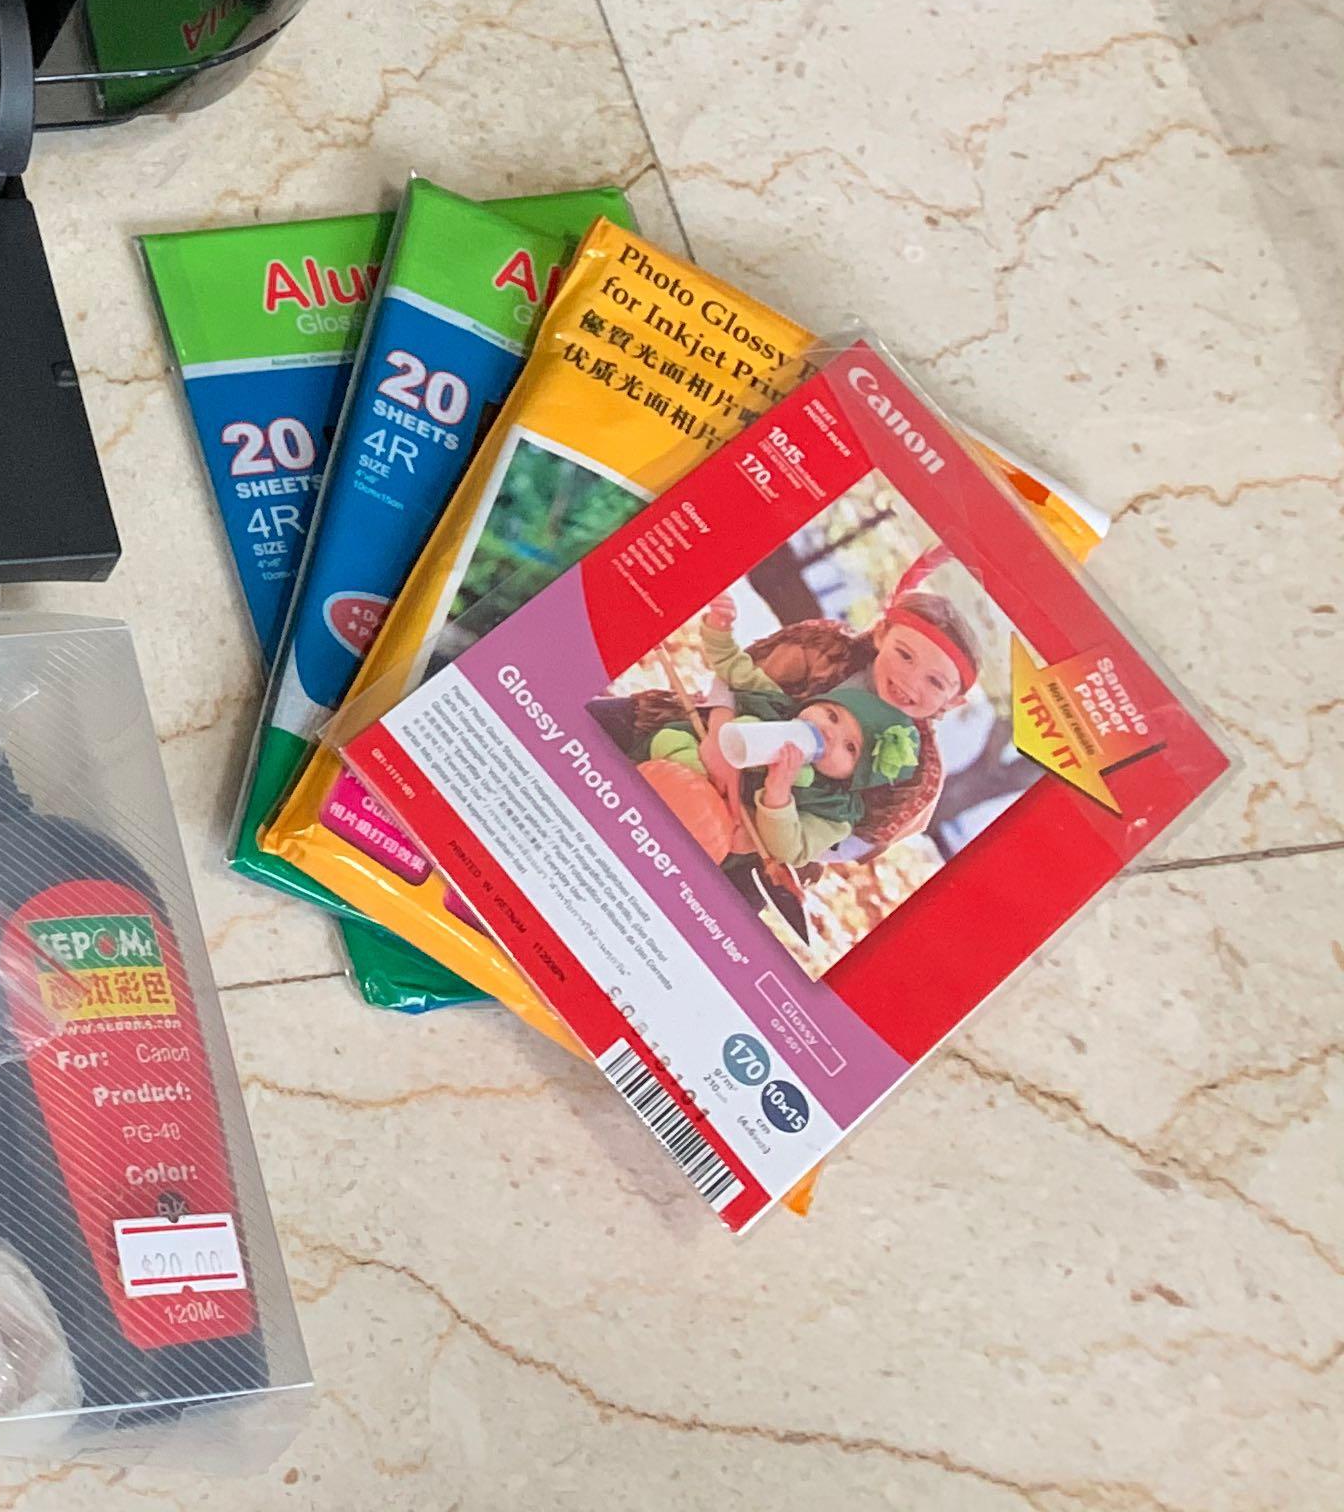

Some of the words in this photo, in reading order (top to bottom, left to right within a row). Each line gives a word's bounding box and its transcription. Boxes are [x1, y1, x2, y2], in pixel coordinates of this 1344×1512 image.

[599, 275, 642, 313] for
[642, 301, 729, 370] Inkjet
[617, 242, 695, 308] Photo
[701, 299, 794, 372] Glossy
[377, 349, 470, 426] 20
[221, 416, 318, 477] 20
[372, 398, 460, 452] SHEETS
[803, 404, 829, 433] PHOTO
[826, 431, 852, 458] PAPER
[848, 367, 946, 474] Canon
[358, 453, 391, 478] SIZE
[363, 428, 419, 475] 4R
[247, 504, 306, 539] 4R
[253, 541, 288, 557] SIZE
[1074, 683, 1112, 736] Pack
[1086, 671, 1130, 733] Paper
[1096, 657, 1148, 736] Sample
[1020, 686, 1065, 739] TRY
[1052, 745, 1082, 769] IT
[498, 665, 565, 742] Glossy
[560, 738, 620, 810] Photo
[618, 807, 681, 878] Paper
[680, 881, 725, 940] "Everyday
[722, 937, 750, 964] Use"
[781, 1001, 819, 1047] Glossy
[57, 1050, 109, 1070] For:
[136, 1043, 191, 1064] Canon
[730, 1040, 766, 1080] 170
[93, 1081, 192, 1107] Product:
[765, 1084, 807, 1131] 10x15
[125, 1162, 198, 1185] Color:
[141, 1250, 223, 1277] $20.00
